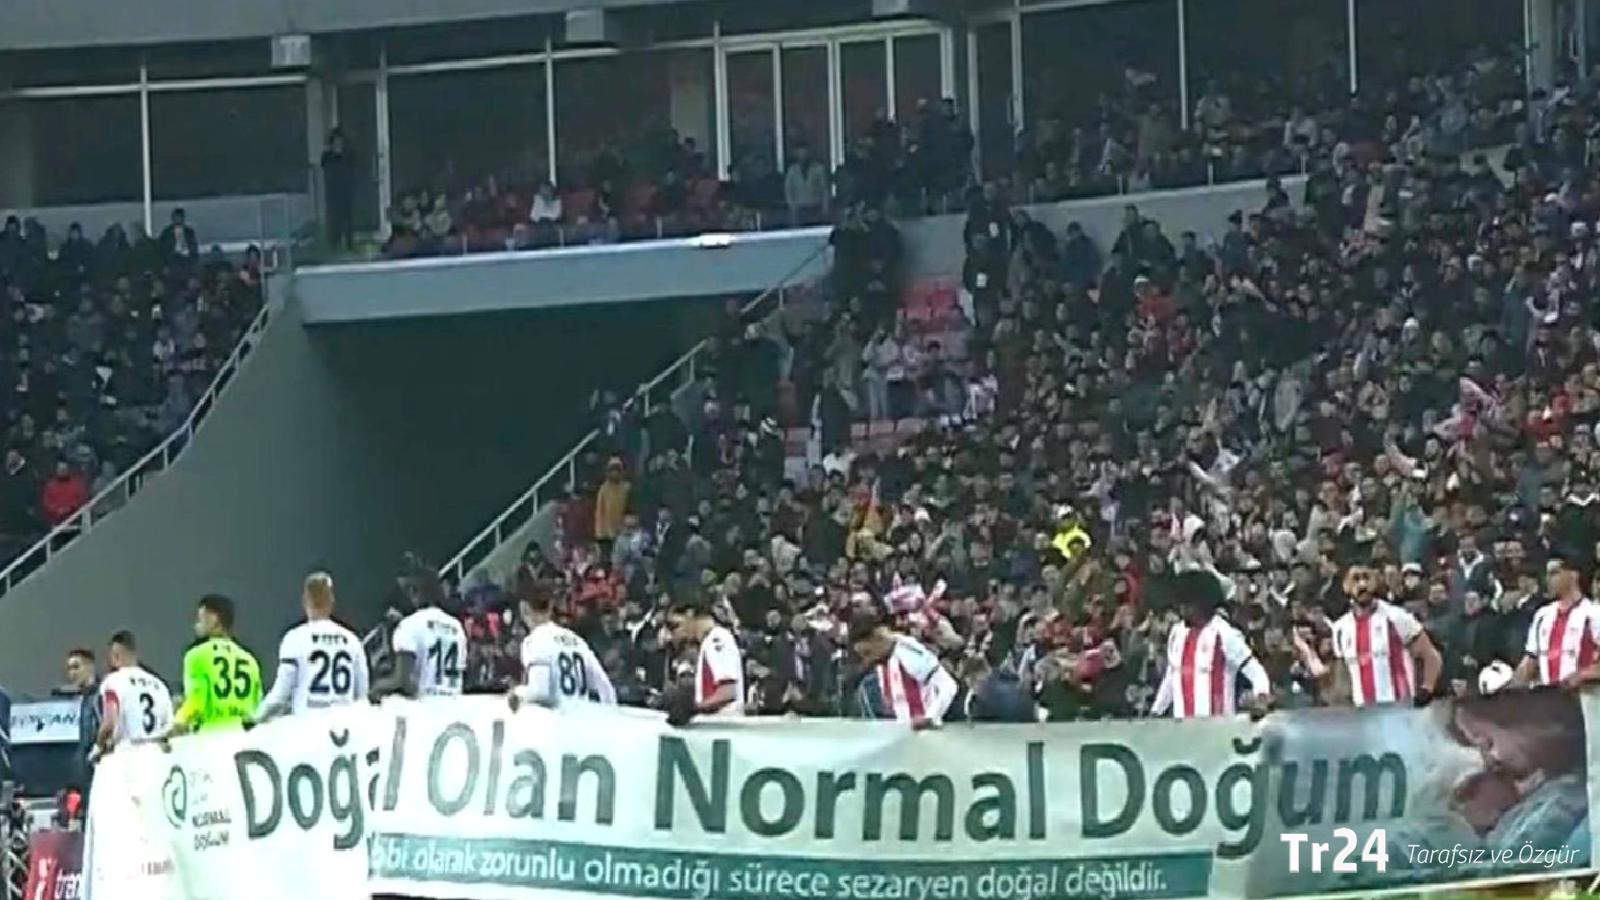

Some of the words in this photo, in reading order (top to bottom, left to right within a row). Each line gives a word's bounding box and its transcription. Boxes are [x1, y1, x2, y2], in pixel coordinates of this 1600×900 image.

[212, 656, 252, 701] 35
[308, 650, 352, 694] 26
[428, 638, 458, 687] 14
[558, 651, 588, 696] 80
[139, 693, 156, 736] 3
[426, 720, 617, 826] Olan
[654, 735, 1047, 841] Normal
[1079, 737, 1408, 860] Doğum
[413, 840, 474, 876] olarak
[480, 848, 574, 881] zorunlu
[584, 852, 720, 899] olmadığı
[730, 866, 829, 897] sürece
[838, 873, 967, 900] sezaryen
[976, 867, 1058, 900] doğal
[1065, 863, 1167, 899] değildir.
